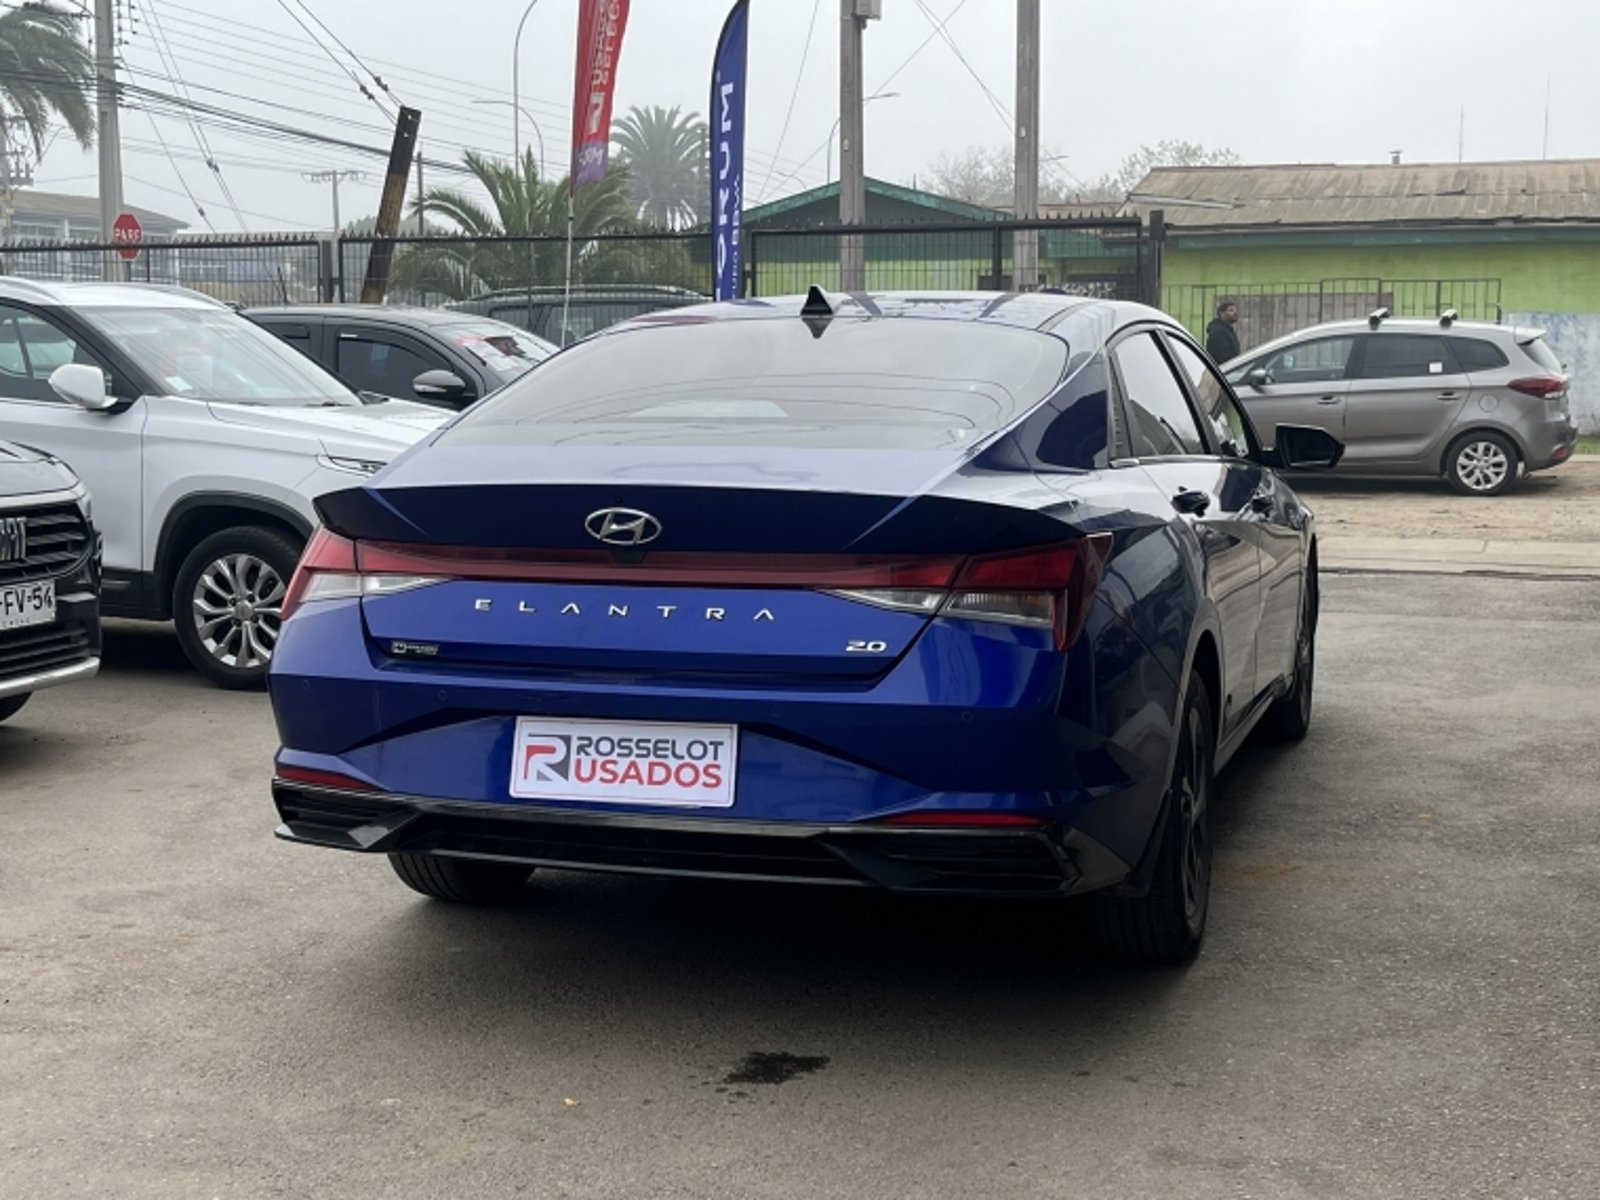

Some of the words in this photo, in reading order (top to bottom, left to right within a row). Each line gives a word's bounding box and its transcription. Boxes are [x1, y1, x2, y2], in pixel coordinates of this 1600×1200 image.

[474, 599, 774, 621] ELANTRA
[576, 736, 724, 761] ROSSELOT
[574, 758, 722, 789] USADOS
